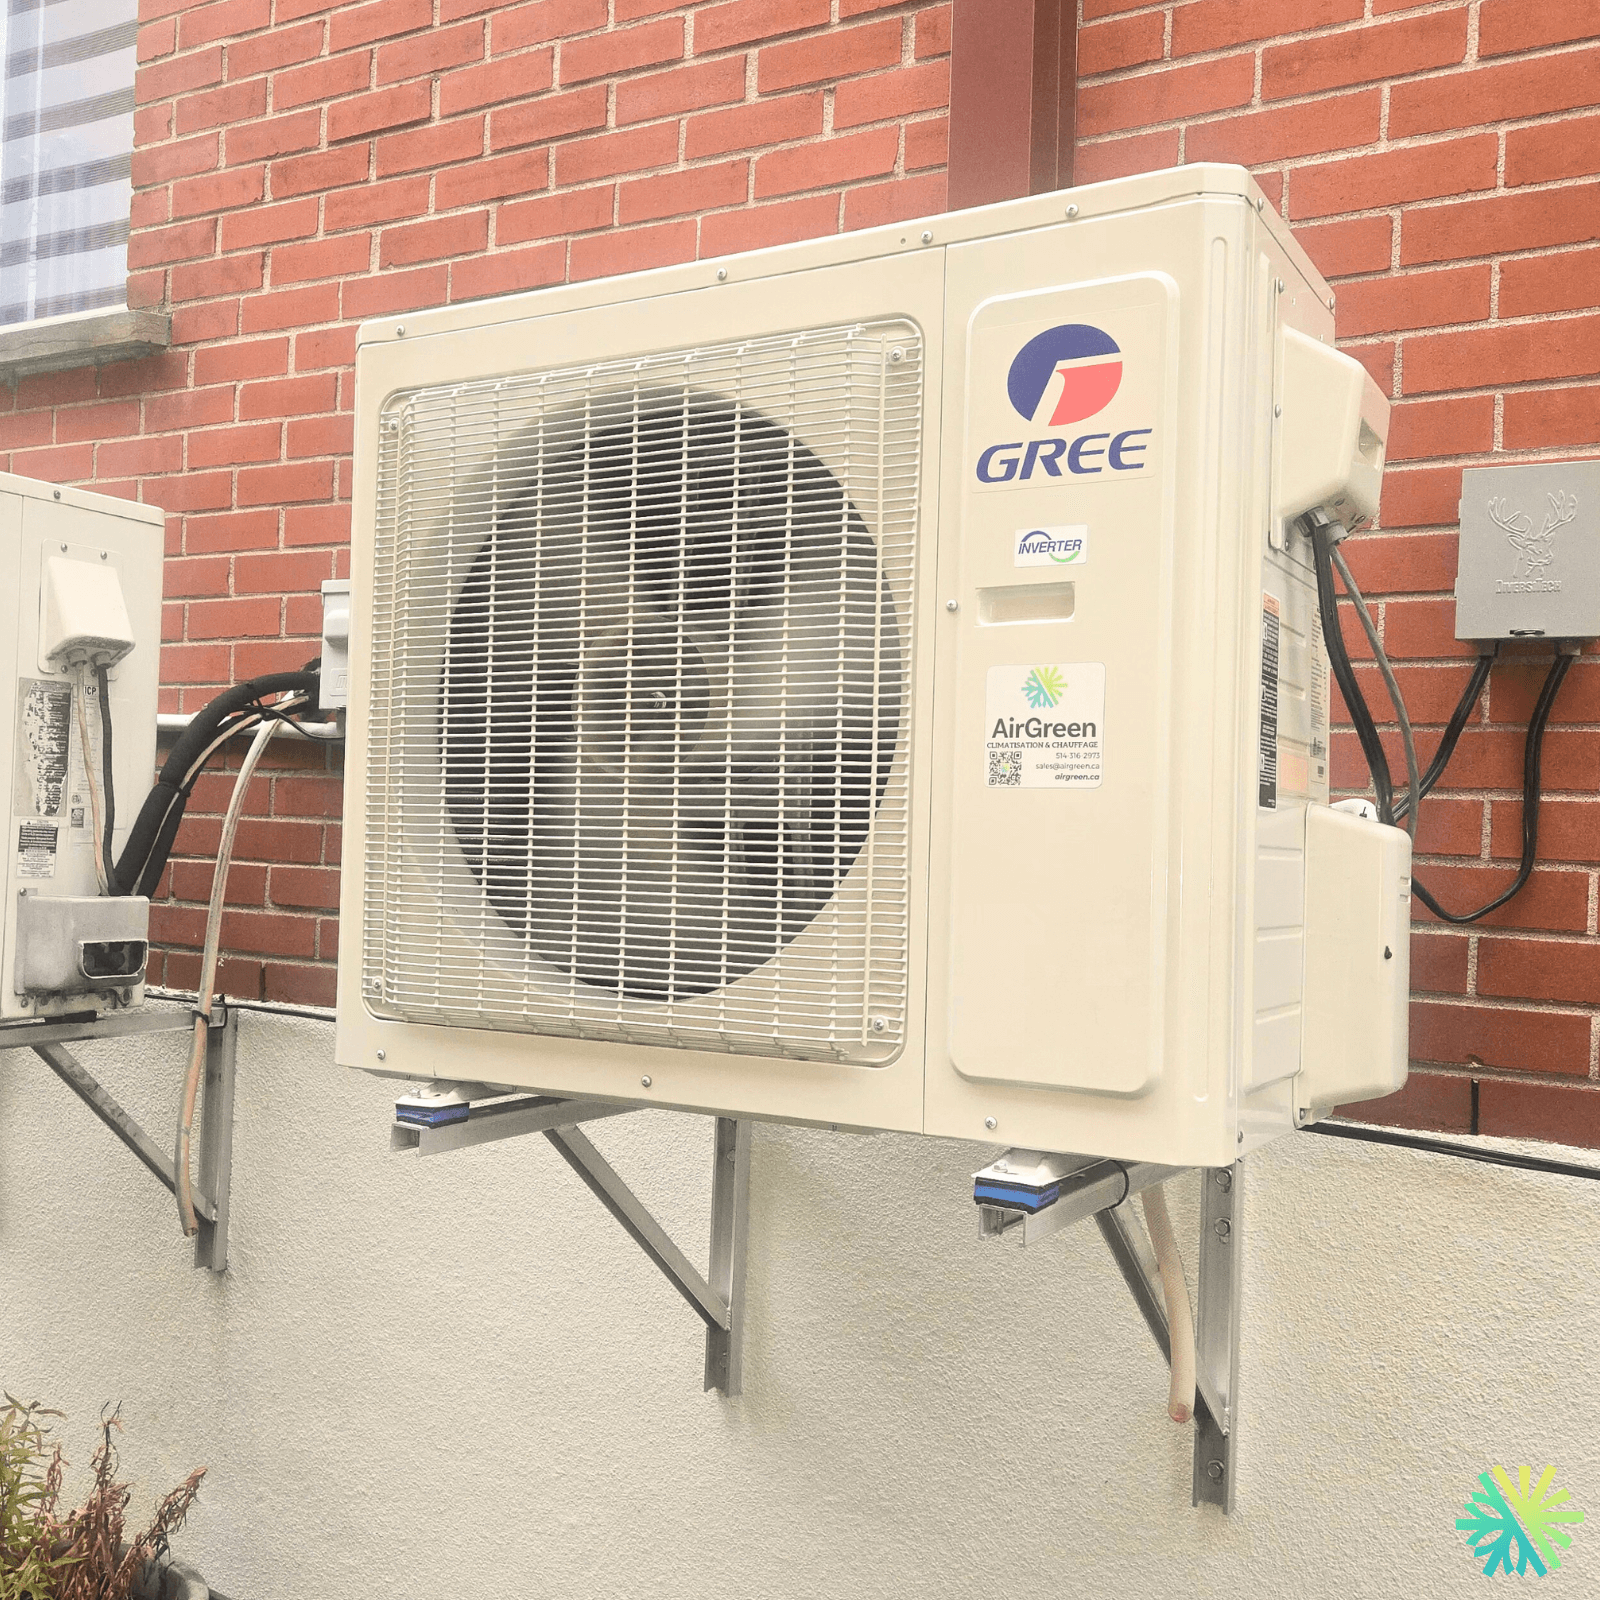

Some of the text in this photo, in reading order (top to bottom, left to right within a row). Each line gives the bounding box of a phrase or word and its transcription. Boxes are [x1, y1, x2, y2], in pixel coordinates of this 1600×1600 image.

[976, 428, 1153, 484] GREE
[1018, 539, 1082, 554] INVERTER
[991, 717, 1097, 739] AirGreen
[1035, 762, 1100, 771] sales@airgreen.ca
[1054, 773, 1100, 781] airgreen.ca
